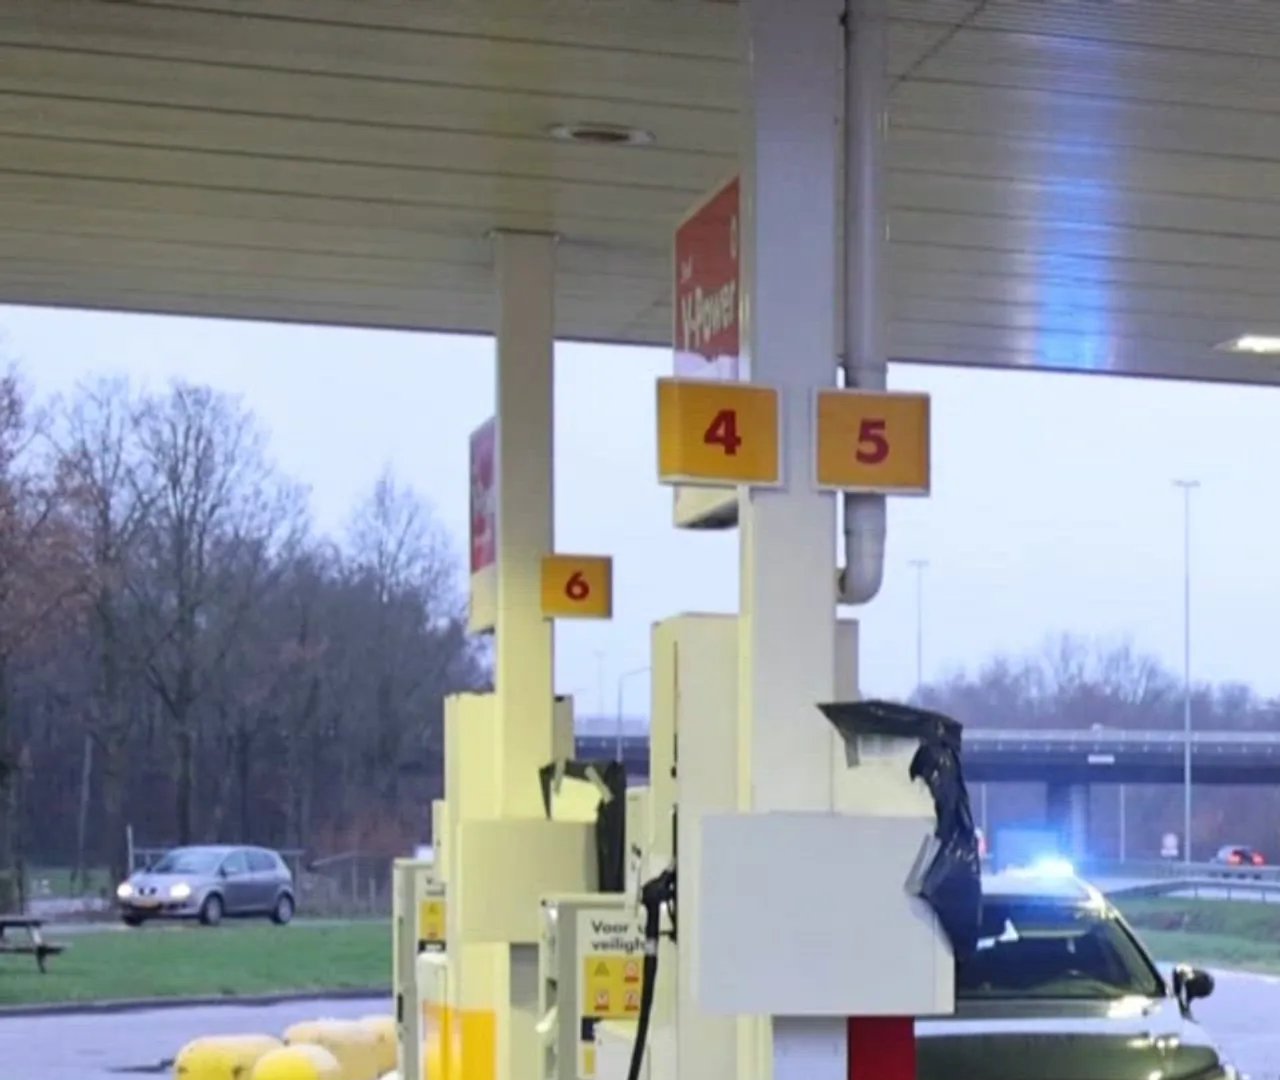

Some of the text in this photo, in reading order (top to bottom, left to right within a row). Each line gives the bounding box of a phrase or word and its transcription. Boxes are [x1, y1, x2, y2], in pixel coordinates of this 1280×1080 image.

[704, 409, 742, 456] 4
[855, 418, 890, 464] 5
[565, 571, 590, 601] 6
[592, 920, 628, 934] Voor
[592, 938, 646, 953] veiligh
